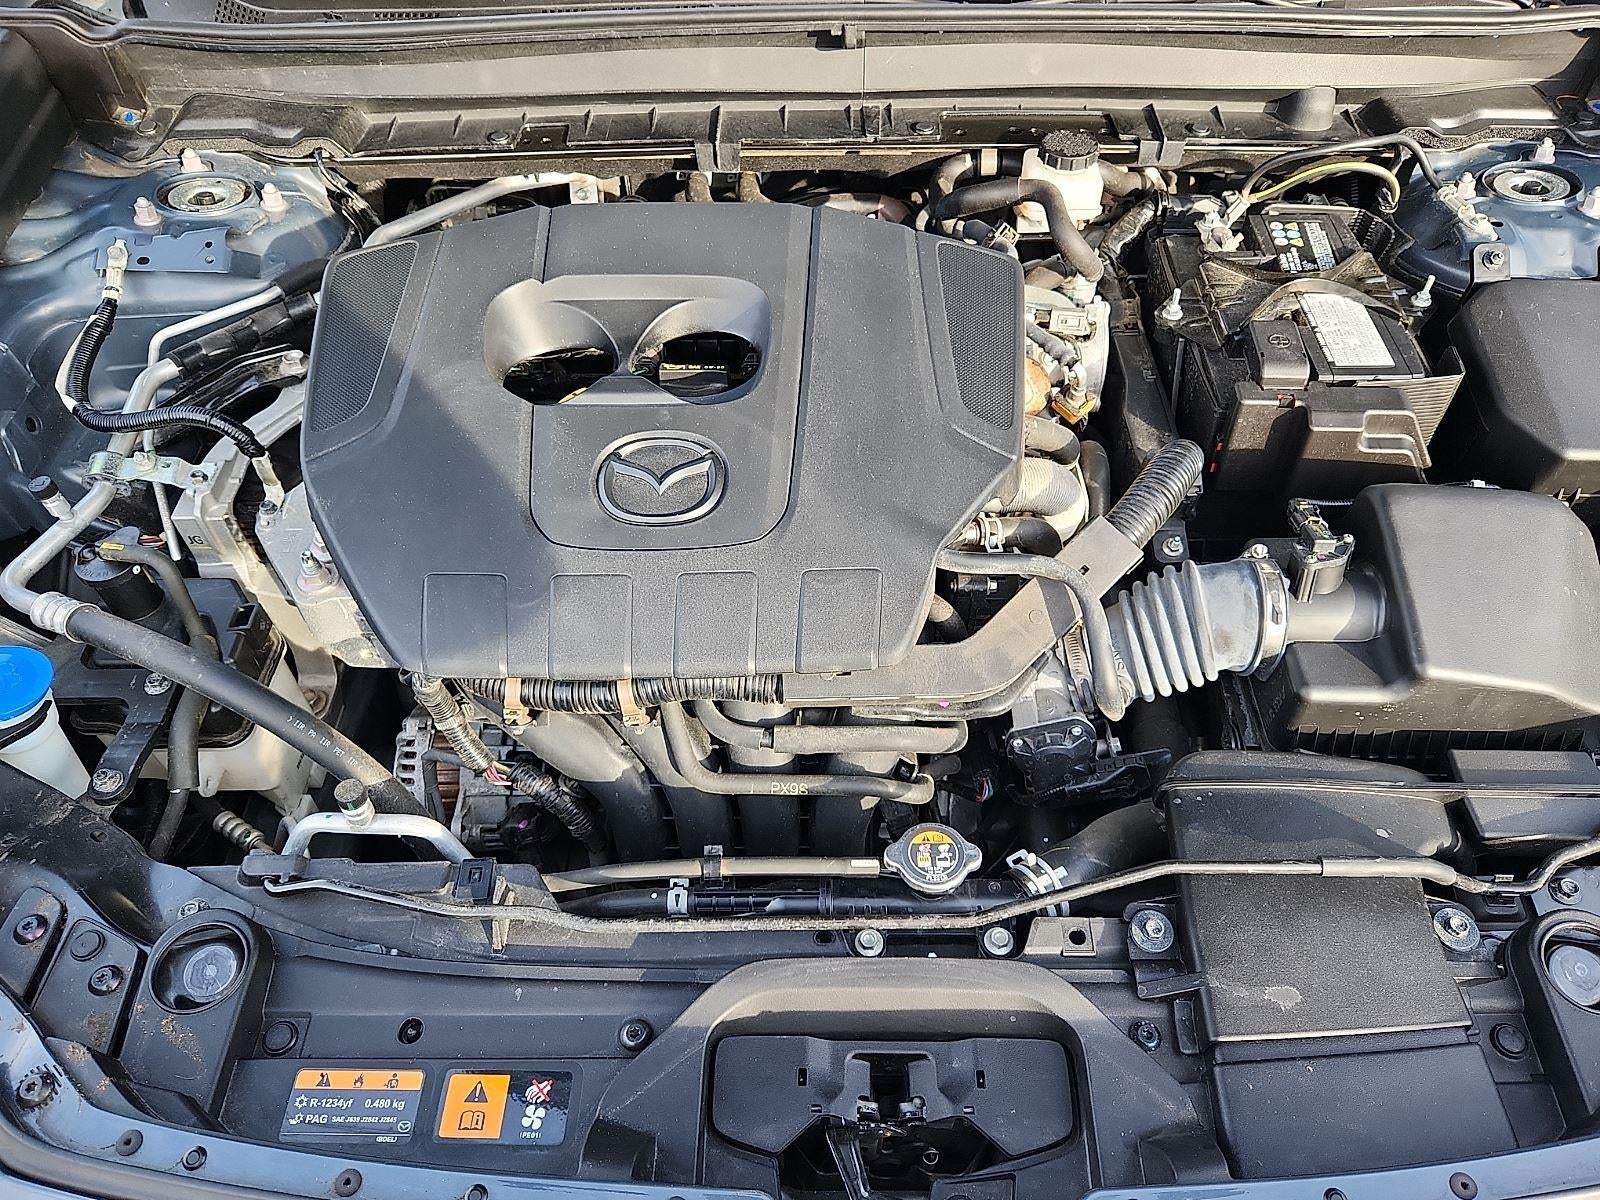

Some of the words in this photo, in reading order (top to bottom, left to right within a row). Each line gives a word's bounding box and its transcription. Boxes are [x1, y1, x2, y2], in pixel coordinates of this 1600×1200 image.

[309, 1098, 354, 1110] R-1234yf
[365, 1098, 391, 1109] 0.480
[392, 1098, 406, 1111] kg
[304, 1114, 329, 1124] PAG
